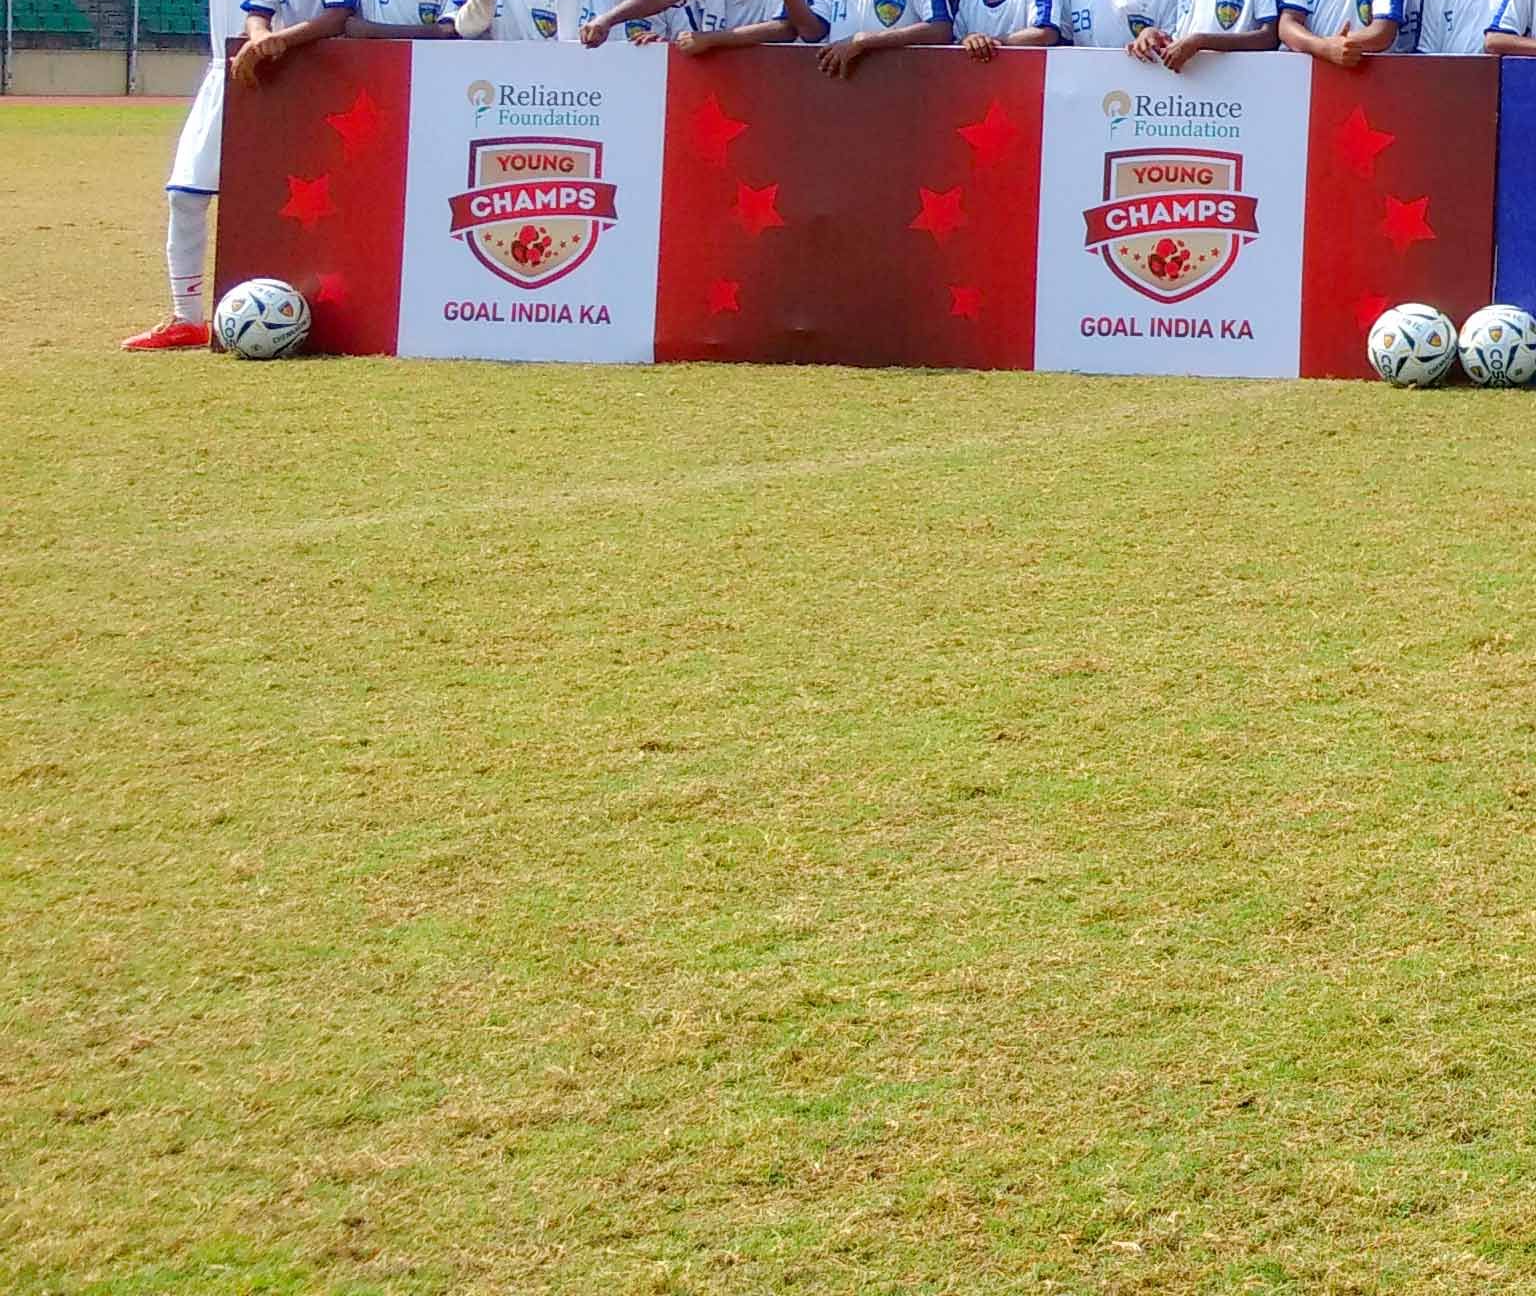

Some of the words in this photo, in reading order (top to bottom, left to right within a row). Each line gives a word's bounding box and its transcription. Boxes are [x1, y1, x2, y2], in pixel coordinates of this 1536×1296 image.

[499, 84, 602, 107] Reliance
[1135, 95, 1242, 118] Reliance
[498, 109, 601, 127] Foundation
[1134, 120, 1241, 138] Foundation
[496, 154, 575, 173] YOUNG
[1133, 166, 1214, 185] YOUNG
[470, 187, 596, 218] CHAMPS
[1105, 199, 1237, 231] CHAMPS
[444, 301, 504, 322] GOAL
[510, 303, 574, 324] INDIA
[579, 304, 611, 325] KA
[1080, 317, 1143, 337] GOAL
[1150, 318, 1214, 339] INDIA
[1220, 319, 1254, 340] KA
